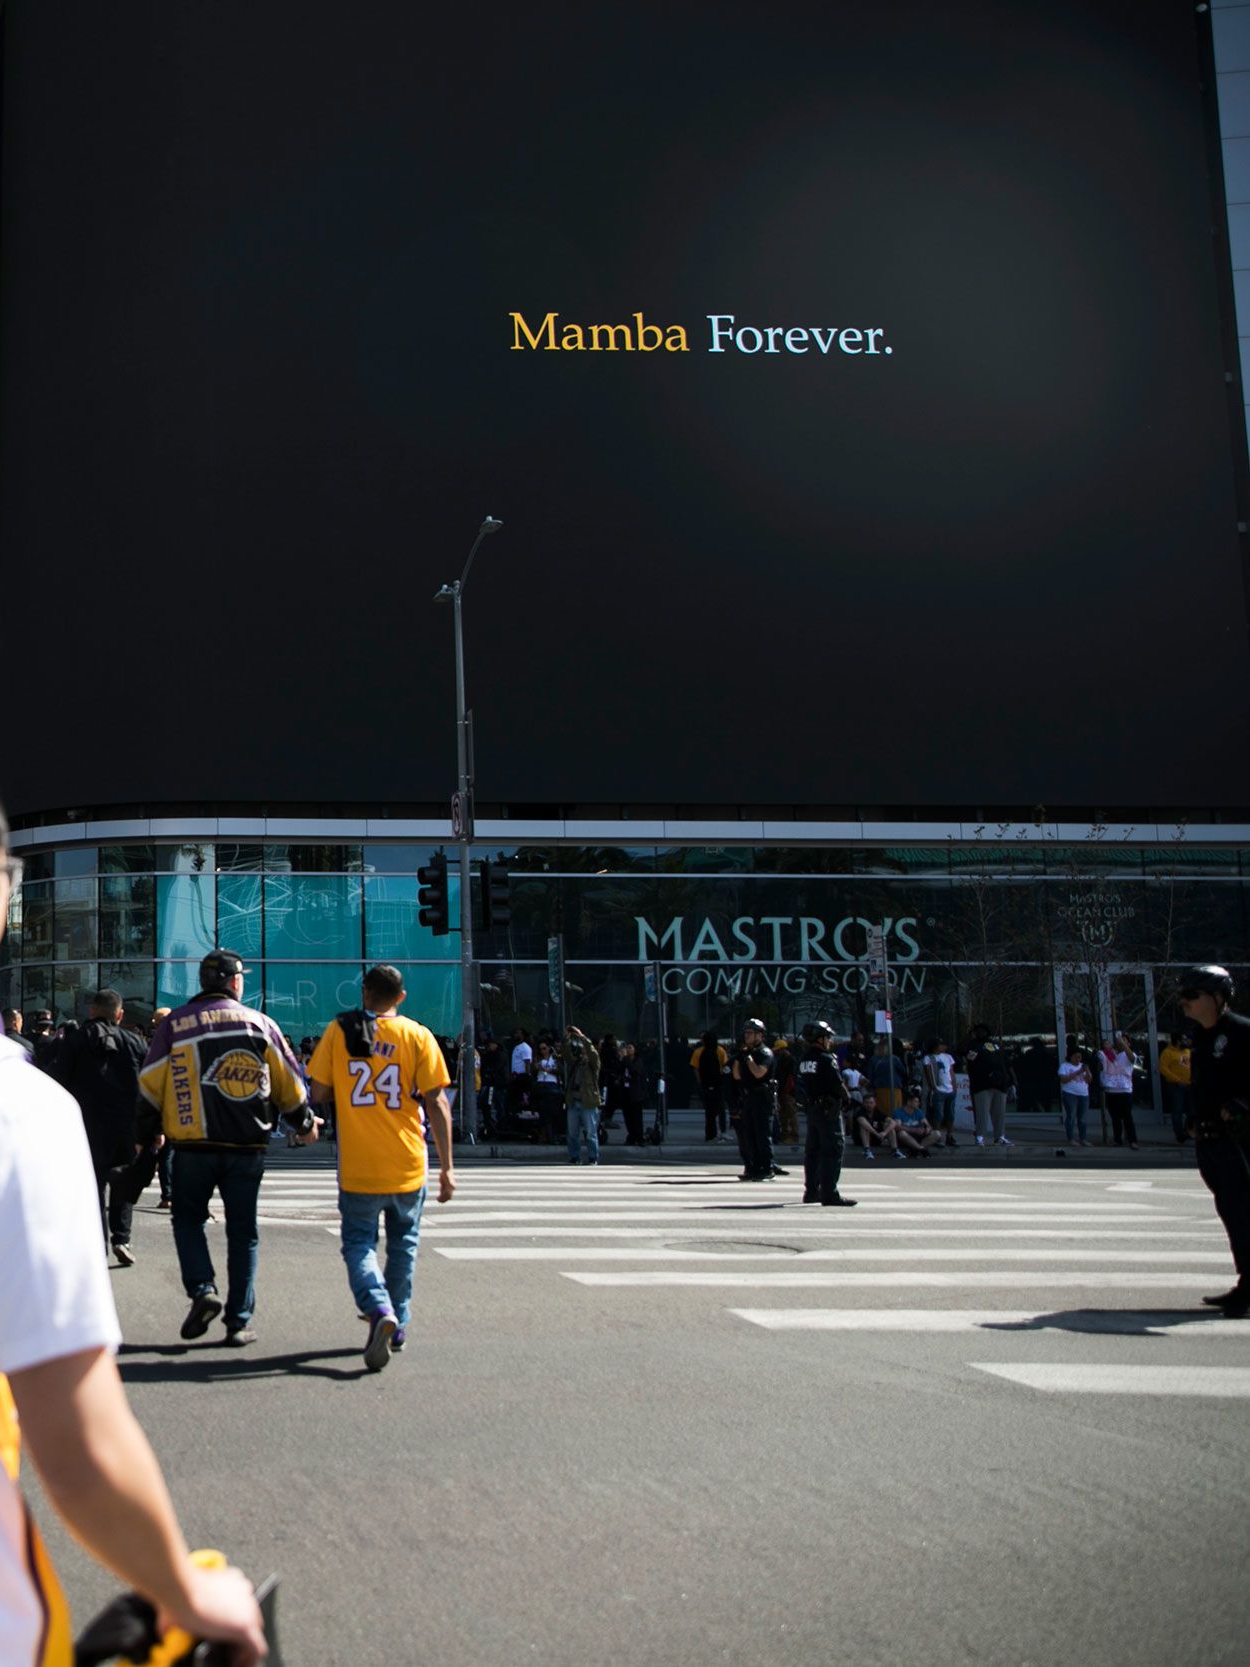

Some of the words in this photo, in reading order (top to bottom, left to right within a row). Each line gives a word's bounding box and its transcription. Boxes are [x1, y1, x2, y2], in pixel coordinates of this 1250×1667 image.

[509, 311, 690, 353] Mamba
[706, 314, 893, 355] Forever.
[1103, 906, 1135, 918] CLUB
[634, 916, 921, 962] MASTRO'S
[661, 967, 807, 994] COMING
[170, 1013, 199, 1034] LOS
[171, 1051, 193, 1126] LAKERS
[348, 1059, 402, 1110] 24
